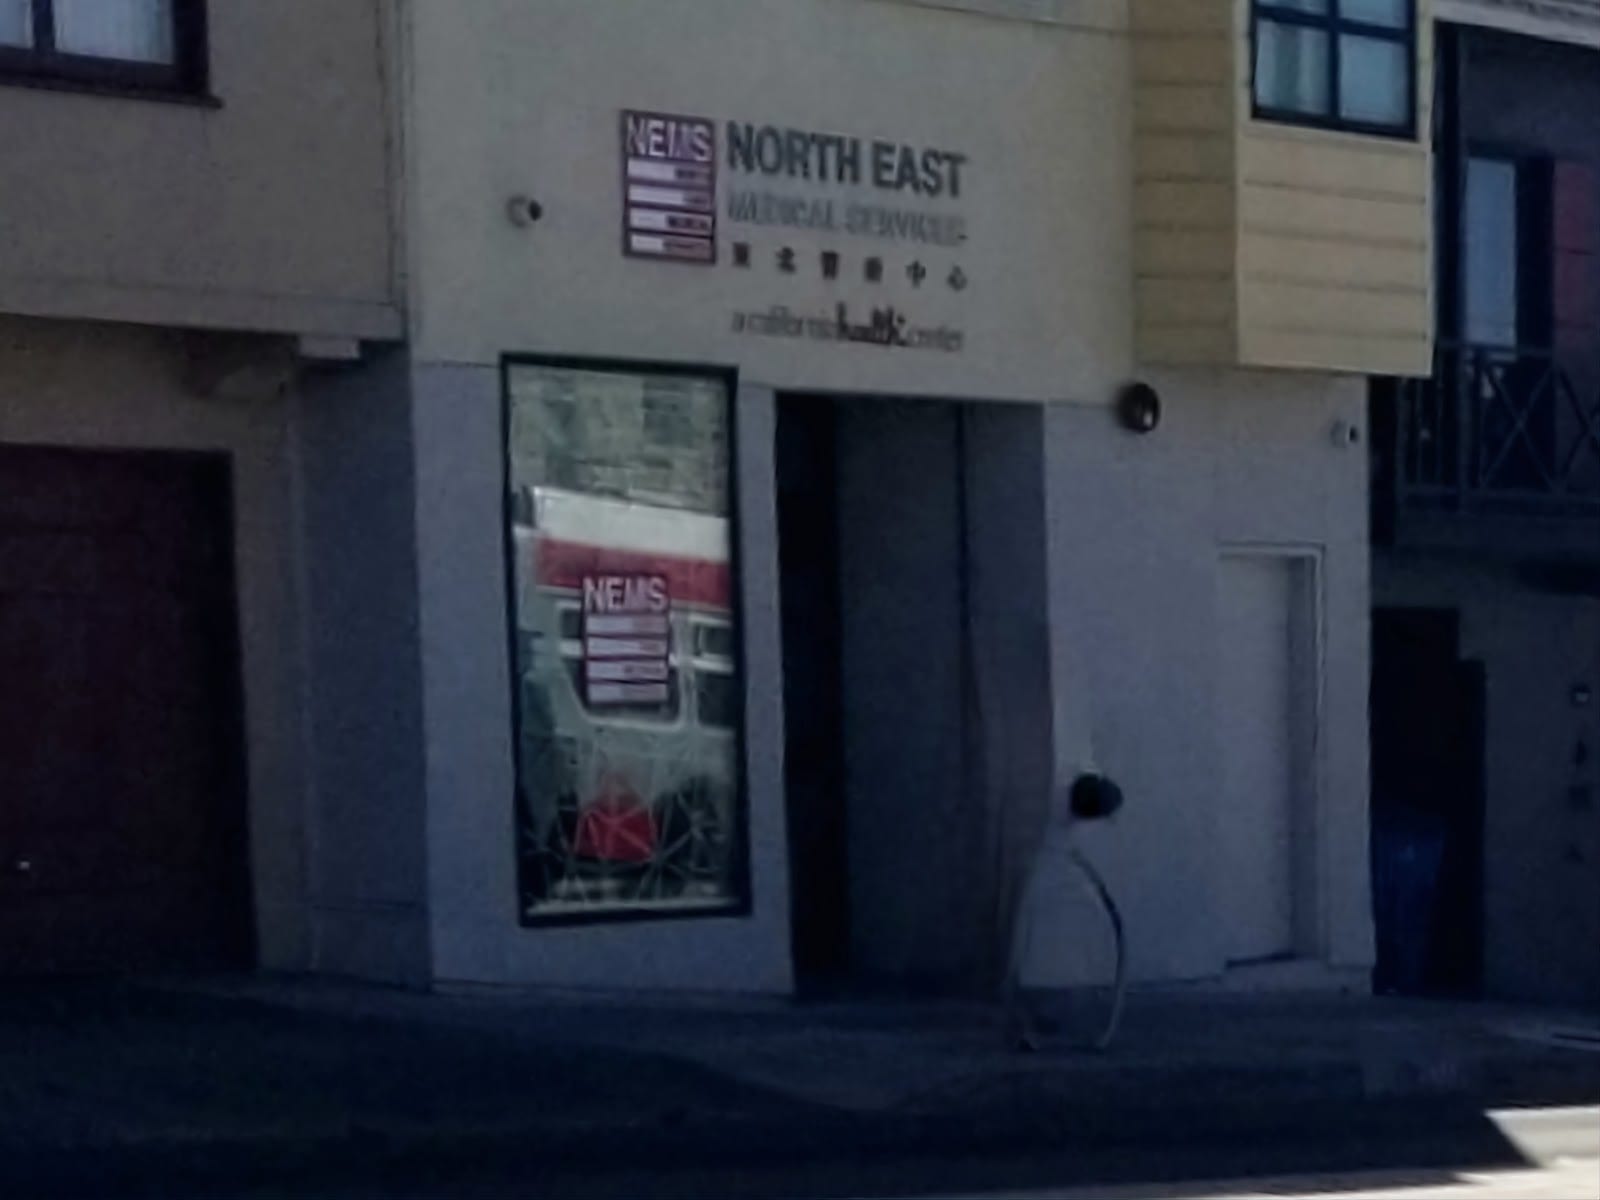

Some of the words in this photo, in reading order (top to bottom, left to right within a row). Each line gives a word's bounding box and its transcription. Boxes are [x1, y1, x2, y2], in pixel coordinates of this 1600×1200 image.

[626, 115, 711, 162] NEMS
[726, 121, 860, 186] NORTH
[873, 143, 967, 198] EAST
[583, 576, 667, 613] NEMS
